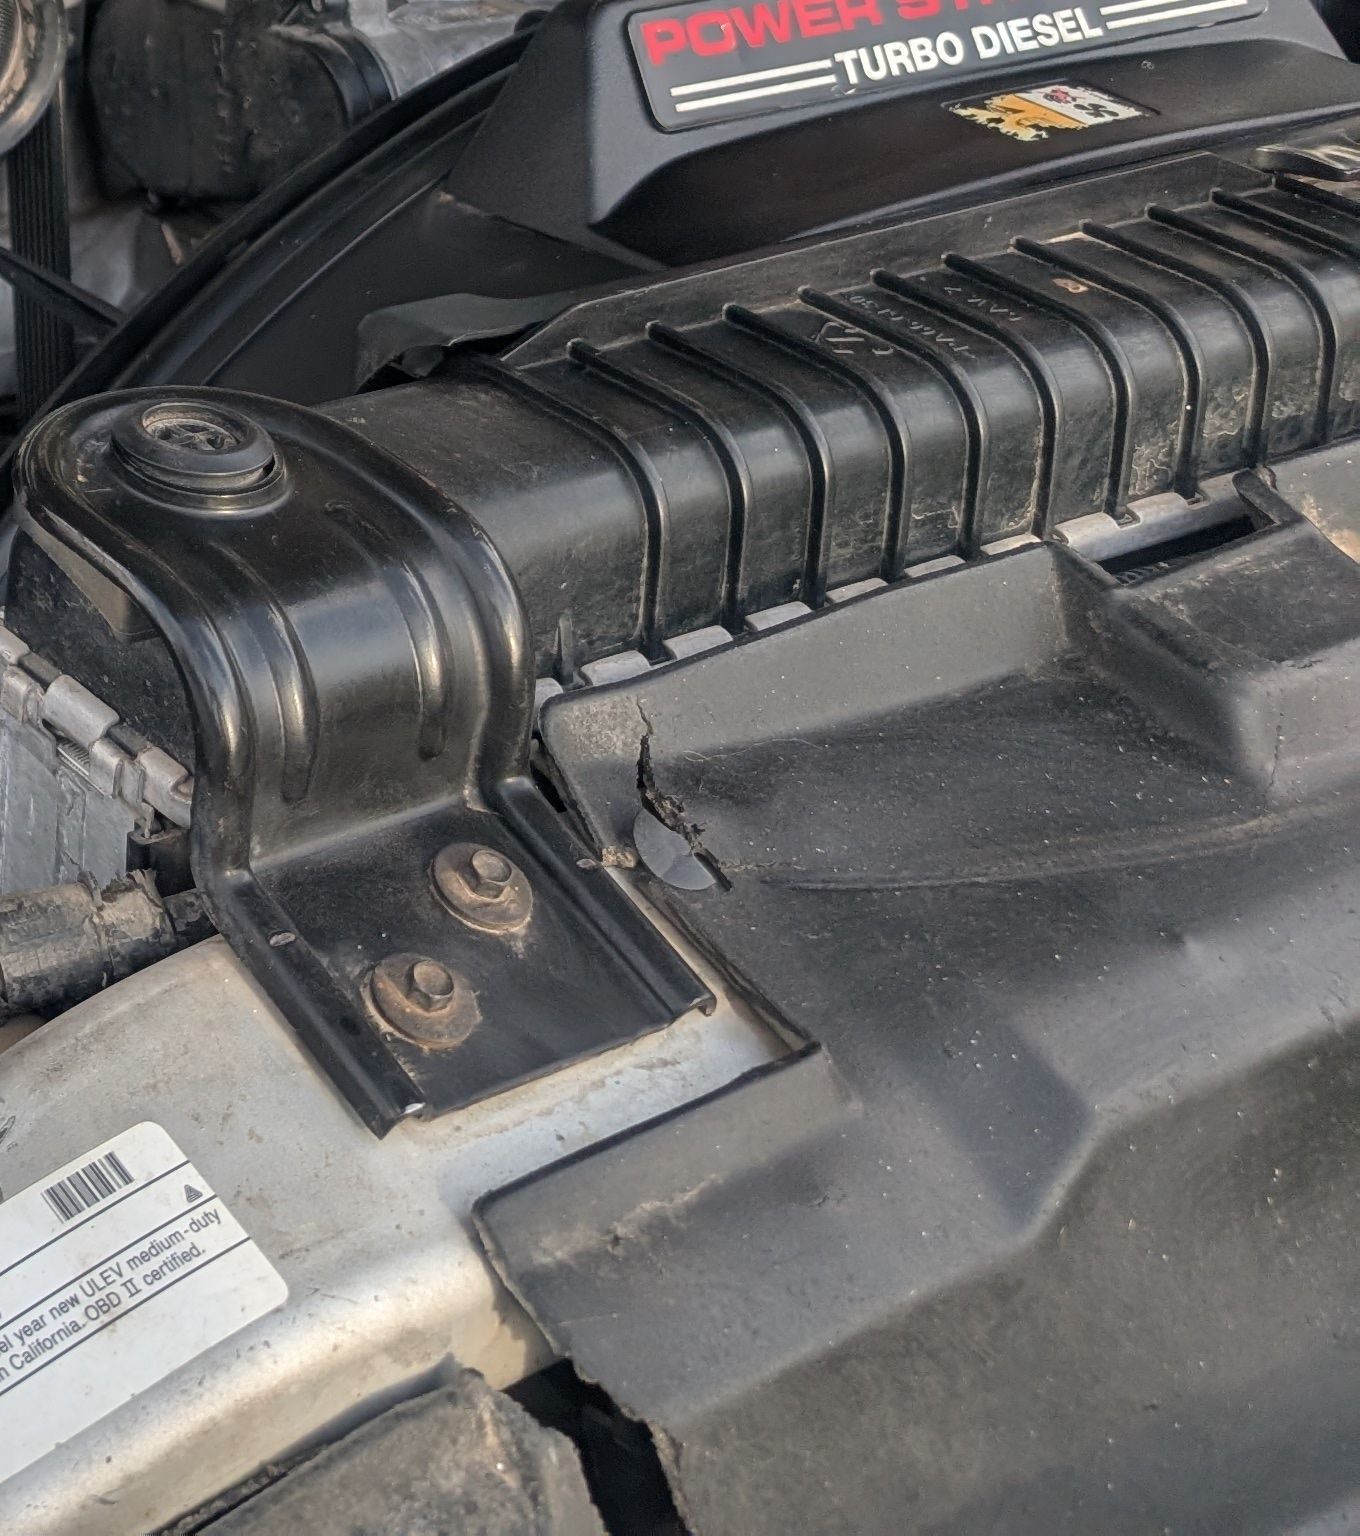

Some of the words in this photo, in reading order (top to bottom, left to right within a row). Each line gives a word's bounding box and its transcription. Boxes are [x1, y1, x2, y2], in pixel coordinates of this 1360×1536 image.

[834, 31, 965, 87] TURBO
[979, 6, 1104, 59] DIESEL
[14, 1315, 49, 1346] year
[49, 1294, 81, 1320] new
[78, 1265, 124, 1299] ULEV
[126, 1207, 222, 1270] medium-duty
[84, 1291, 122, 1322] OBD
[126, 1276, 143, 1298] II
[141, 1244, 207, 1287] certified.
